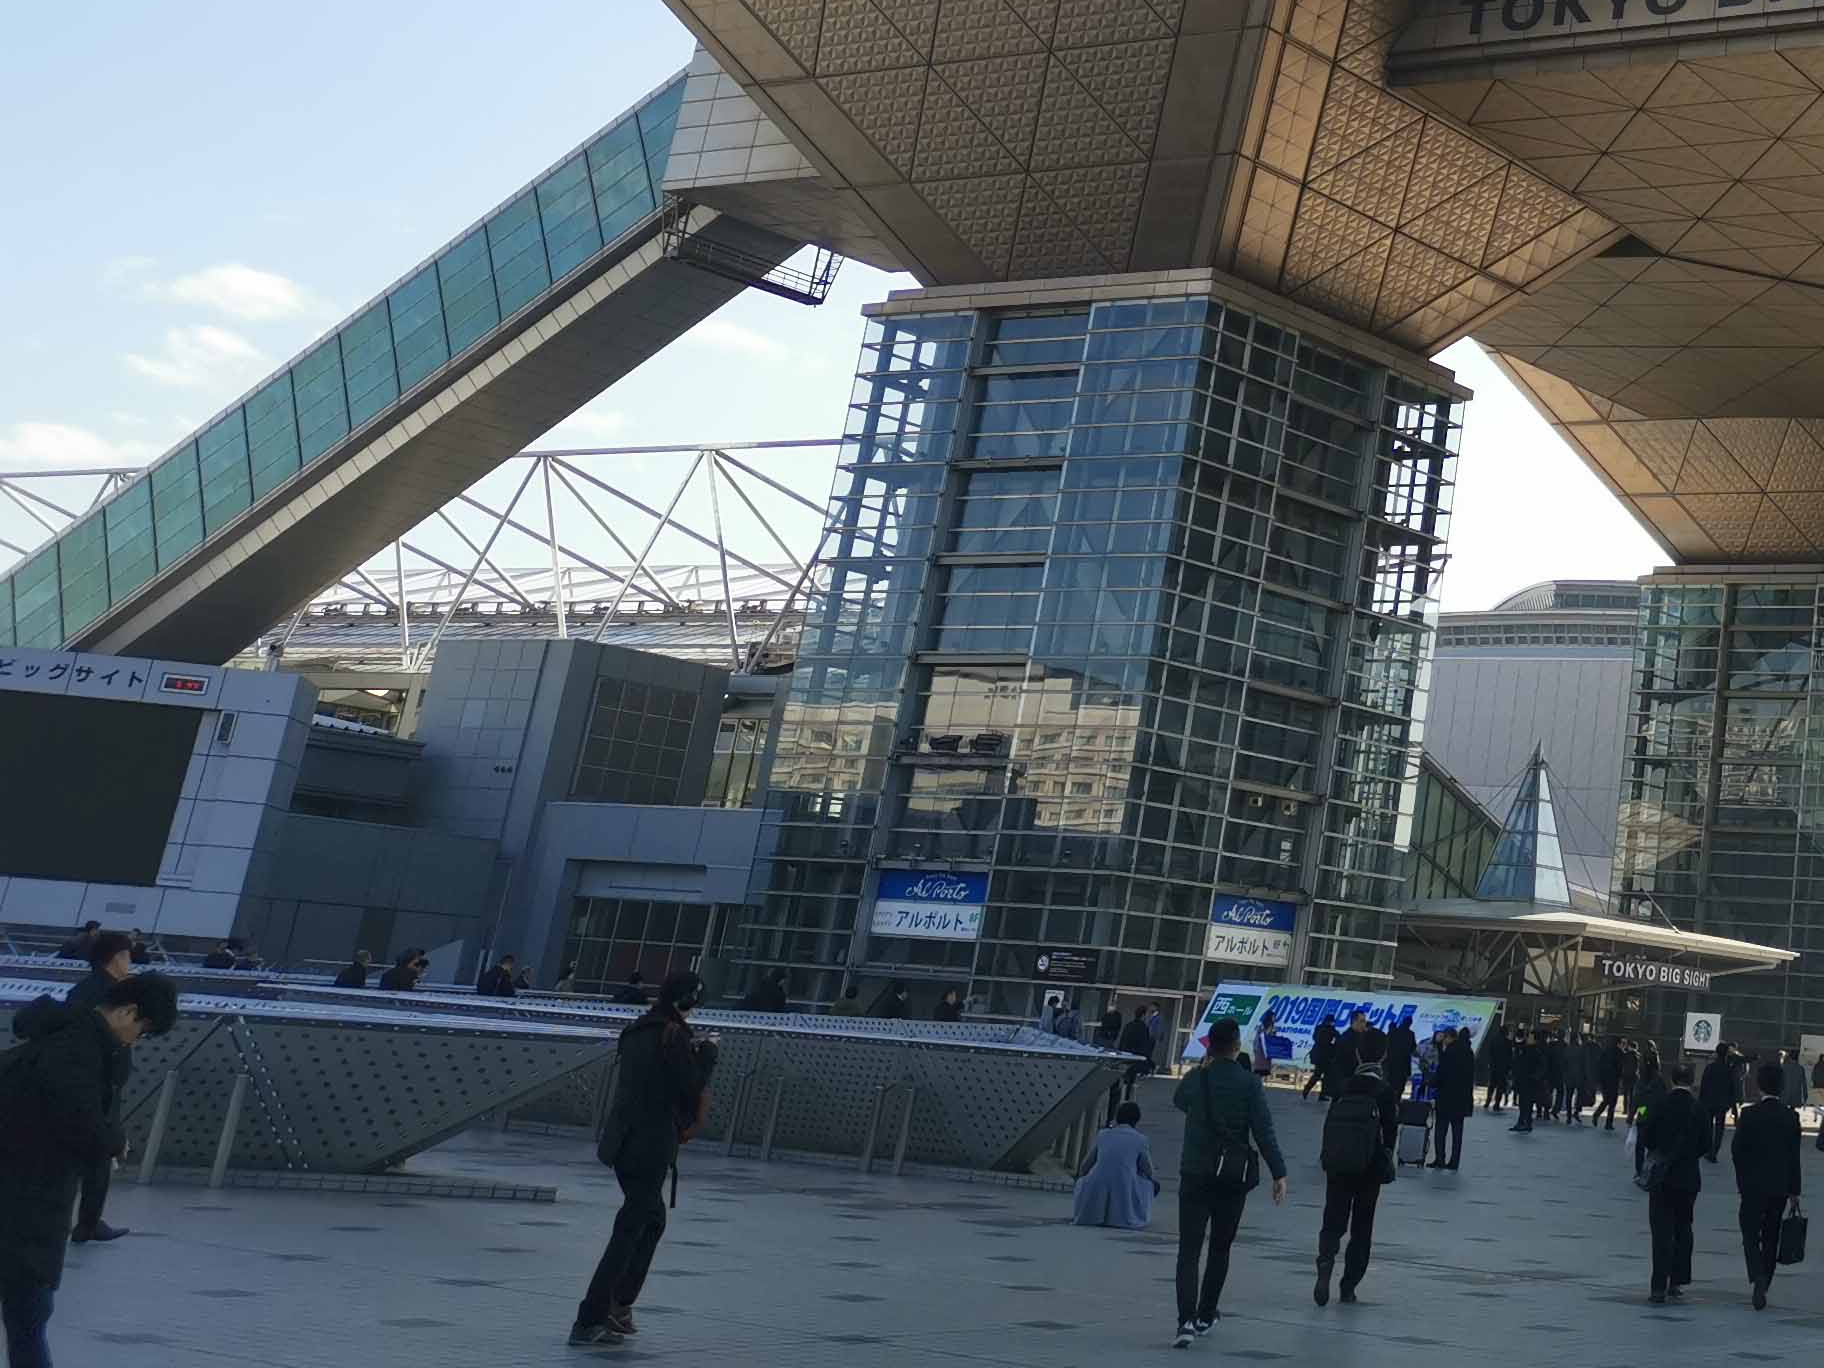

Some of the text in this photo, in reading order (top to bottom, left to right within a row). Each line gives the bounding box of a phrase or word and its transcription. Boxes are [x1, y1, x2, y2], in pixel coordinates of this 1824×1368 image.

[1602, 959, 1711, 988] TOKYO BIG SIGHT
[1210, 996, 1255, 1016] 西ホール
